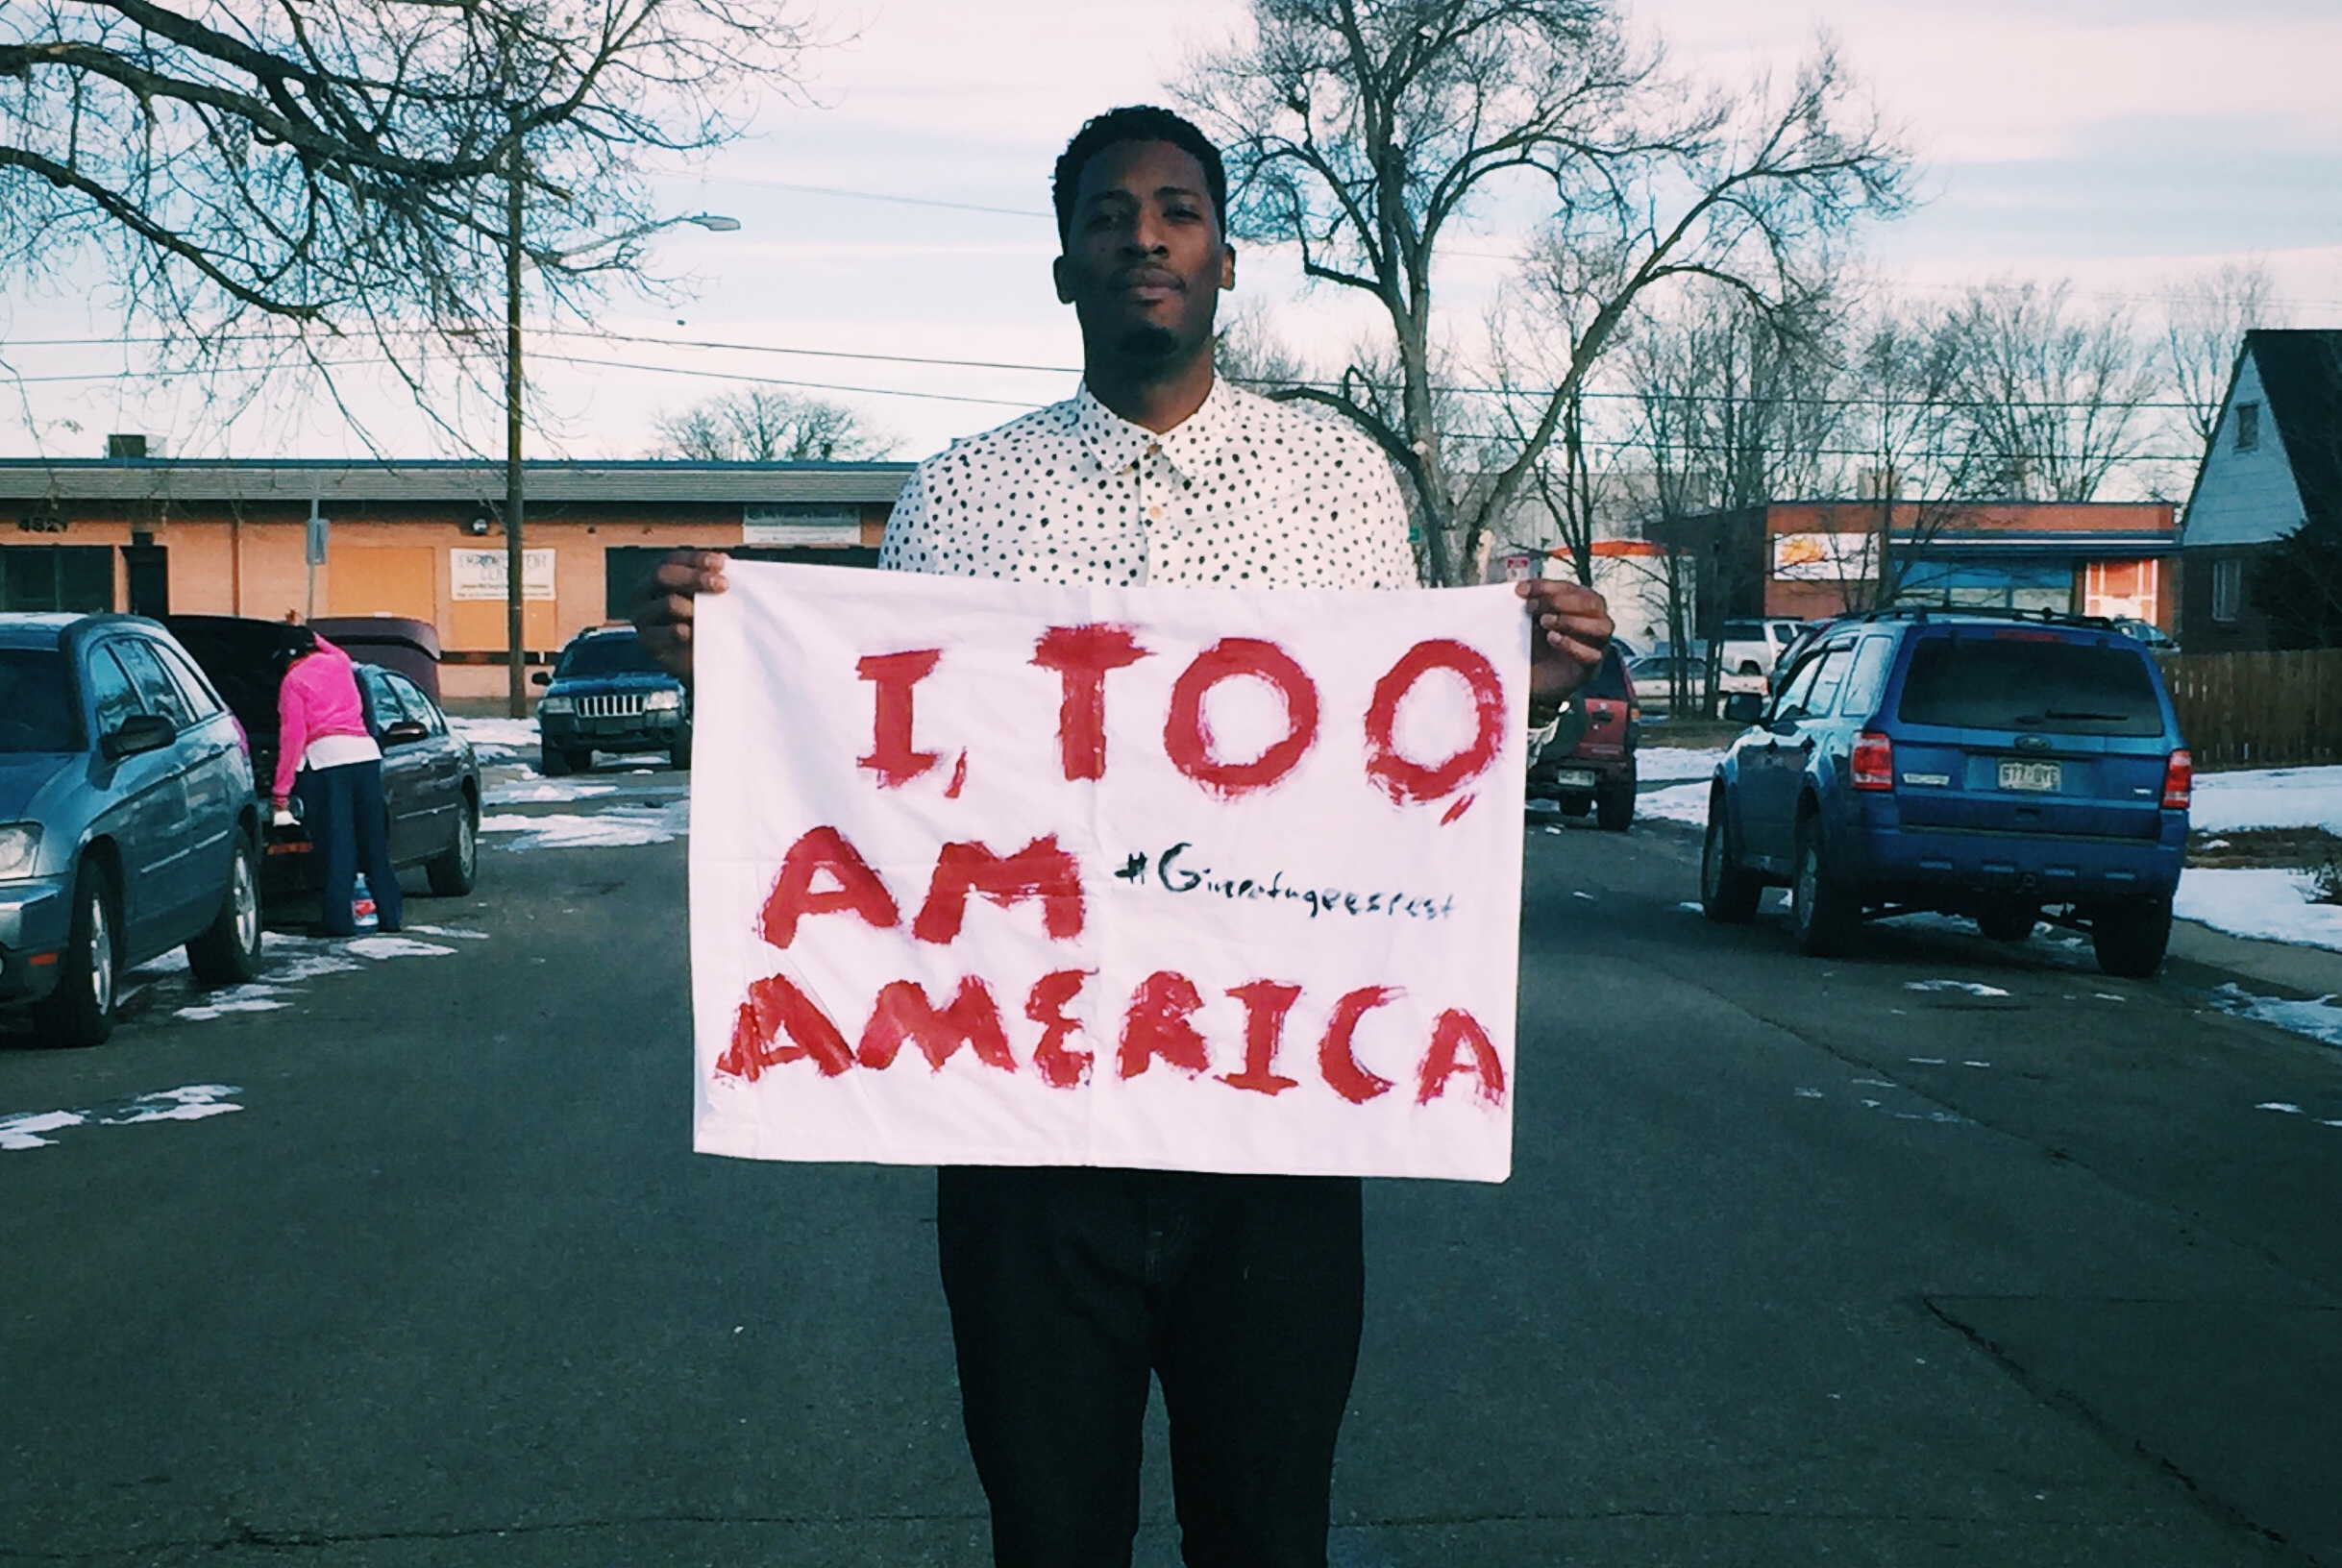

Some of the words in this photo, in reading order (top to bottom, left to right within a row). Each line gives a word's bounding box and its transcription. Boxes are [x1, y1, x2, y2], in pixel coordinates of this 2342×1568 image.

[856, 647, 967, 799] I,
[1028, 622, 1507, 825] TOO,
[756, 825, 1087, 948] AM
[715, 969, 1507, 1109] AMERICA
